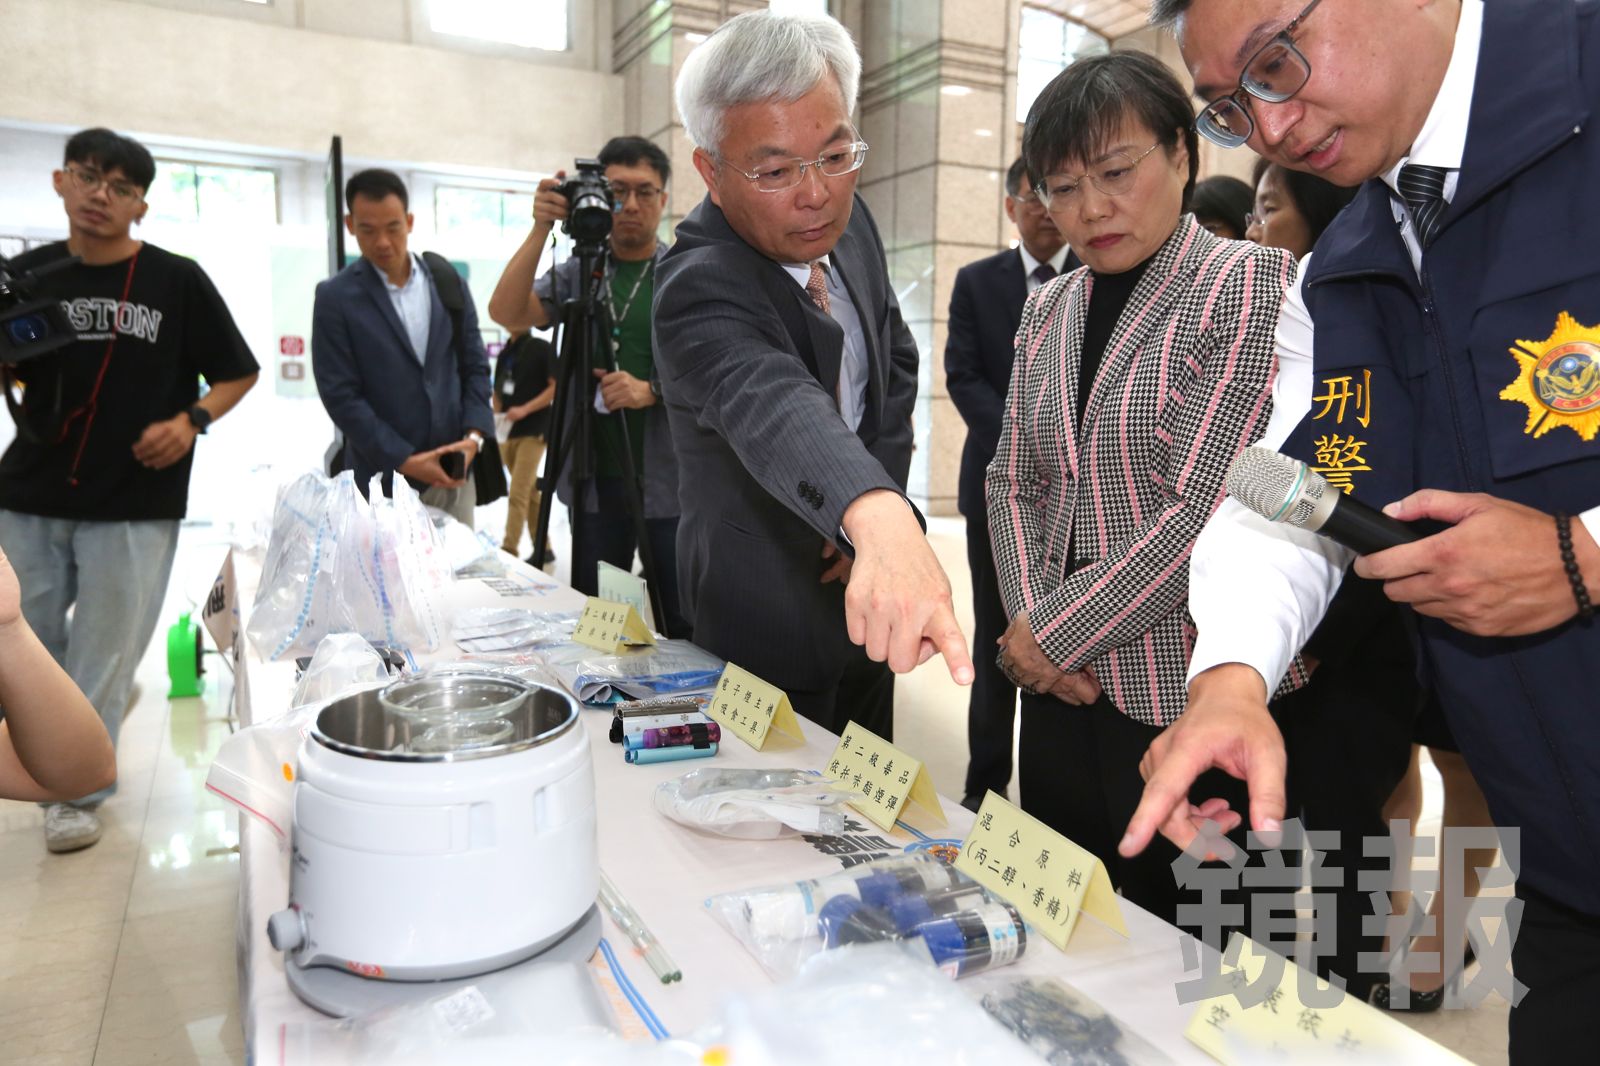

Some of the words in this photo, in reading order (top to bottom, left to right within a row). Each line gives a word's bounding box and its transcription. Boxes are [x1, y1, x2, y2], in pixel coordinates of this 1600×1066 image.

[60, 298, 163, 343] STON
[1310, 368, 1372, 496] 刑警
[721, 677, 774, 718] 電子煙主機
[829, 758, 898, 812] 依托咪酯煙彈
[841, 735, 909, 785] 第二級毒品
[979, 812, 1082, 892] 混合原料
[966, 839, 1070, 926] (丙二醇、香精)
